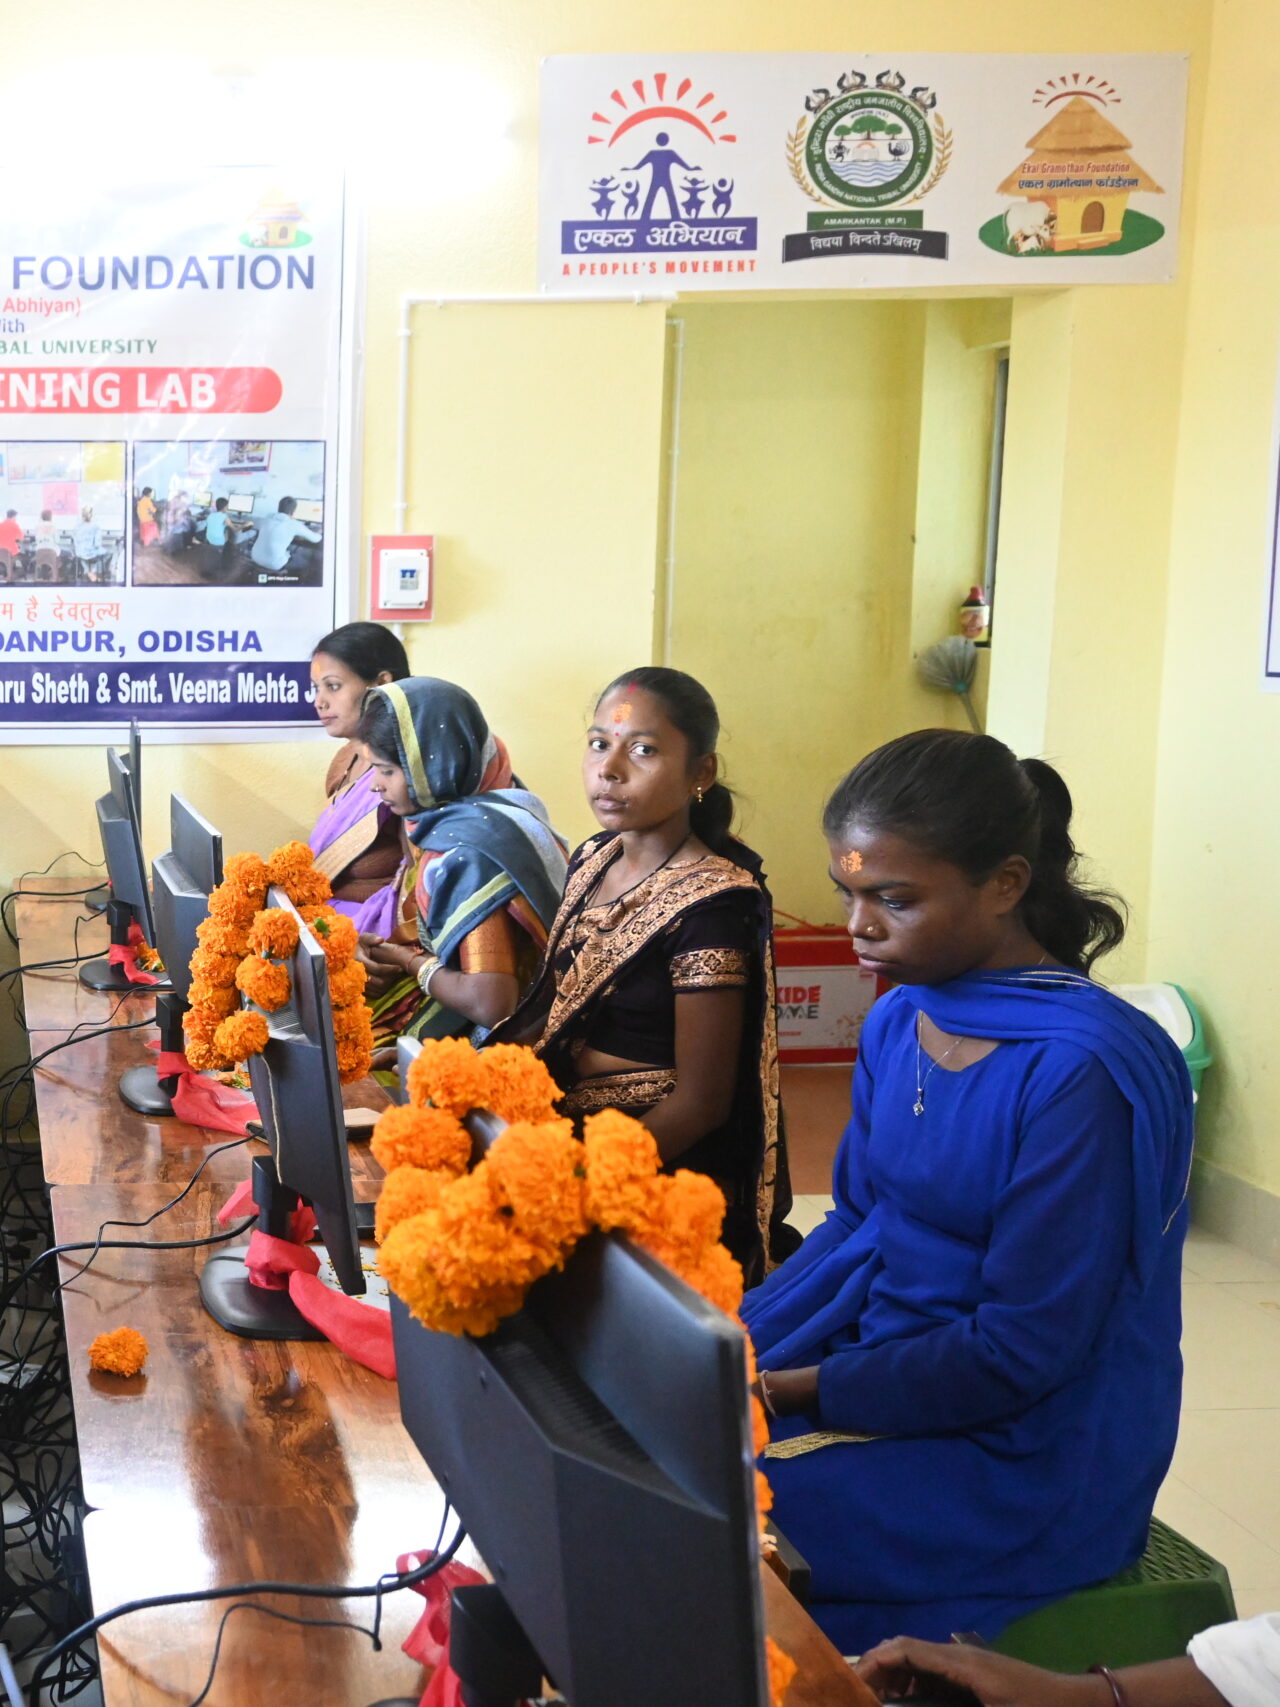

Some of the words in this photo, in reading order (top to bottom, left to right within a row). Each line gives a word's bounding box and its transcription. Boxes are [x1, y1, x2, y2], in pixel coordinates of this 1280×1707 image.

[1087, 162, 1130, 173] Foundation
[824, 217, 882, 226] AMARKANTAK
[574, 228, 636, 252] एकल
[646, 221, 747, 246] अभियान
[13, 254, 316, 291] FOUNDATION
[562, 263, 570, 276] A
[579, 262, 657, 276] PEOPLE'S
[665, 259, 757, 274] MOVEMENT
[2, 296, 82, 317] Abhiyan)
[41, 339, 159, 355] UNIVERSITY
[137, 372, 217, 409] LAB
[26, 596, 39, 622] है
[51, 595, 121, 629] देवतुल्य
[138, 629, 263, 653] ODISHA
[31, 672, 90, 704] Sheth
[96, 672, 111, 704] &
[117, 672, 163, 704] Smt.
[169, 672, 231, 703] Veena
[237, 672, 299, 703] Mehta
[304, 680, 316, 704] J
